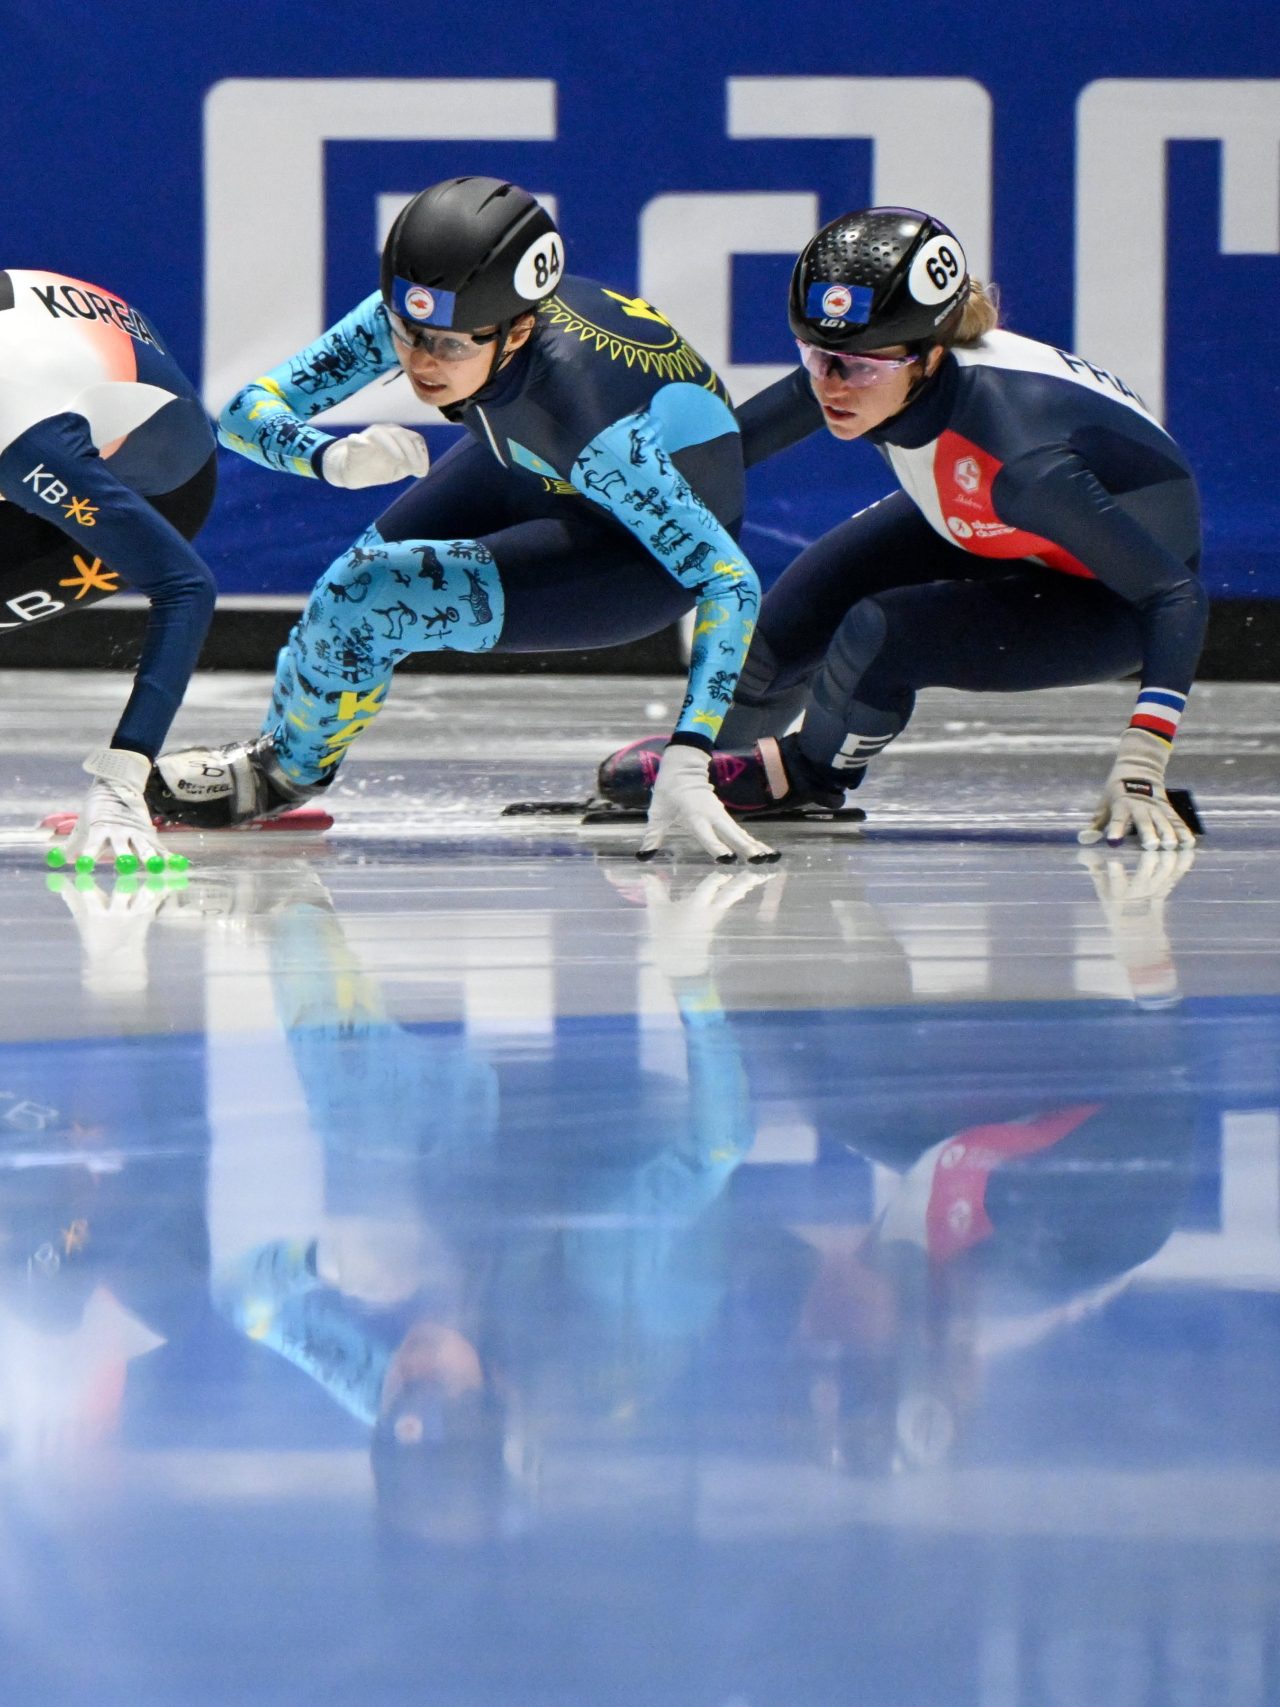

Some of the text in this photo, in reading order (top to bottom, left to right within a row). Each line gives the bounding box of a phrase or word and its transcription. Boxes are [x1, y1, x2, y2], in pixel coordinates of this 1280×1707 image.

[534, 241, 560, 289] 84
[926, 245, 959, 290] 69
[30, 285, 166, 356] KOREA
[22, 463, 68, 504] KB
